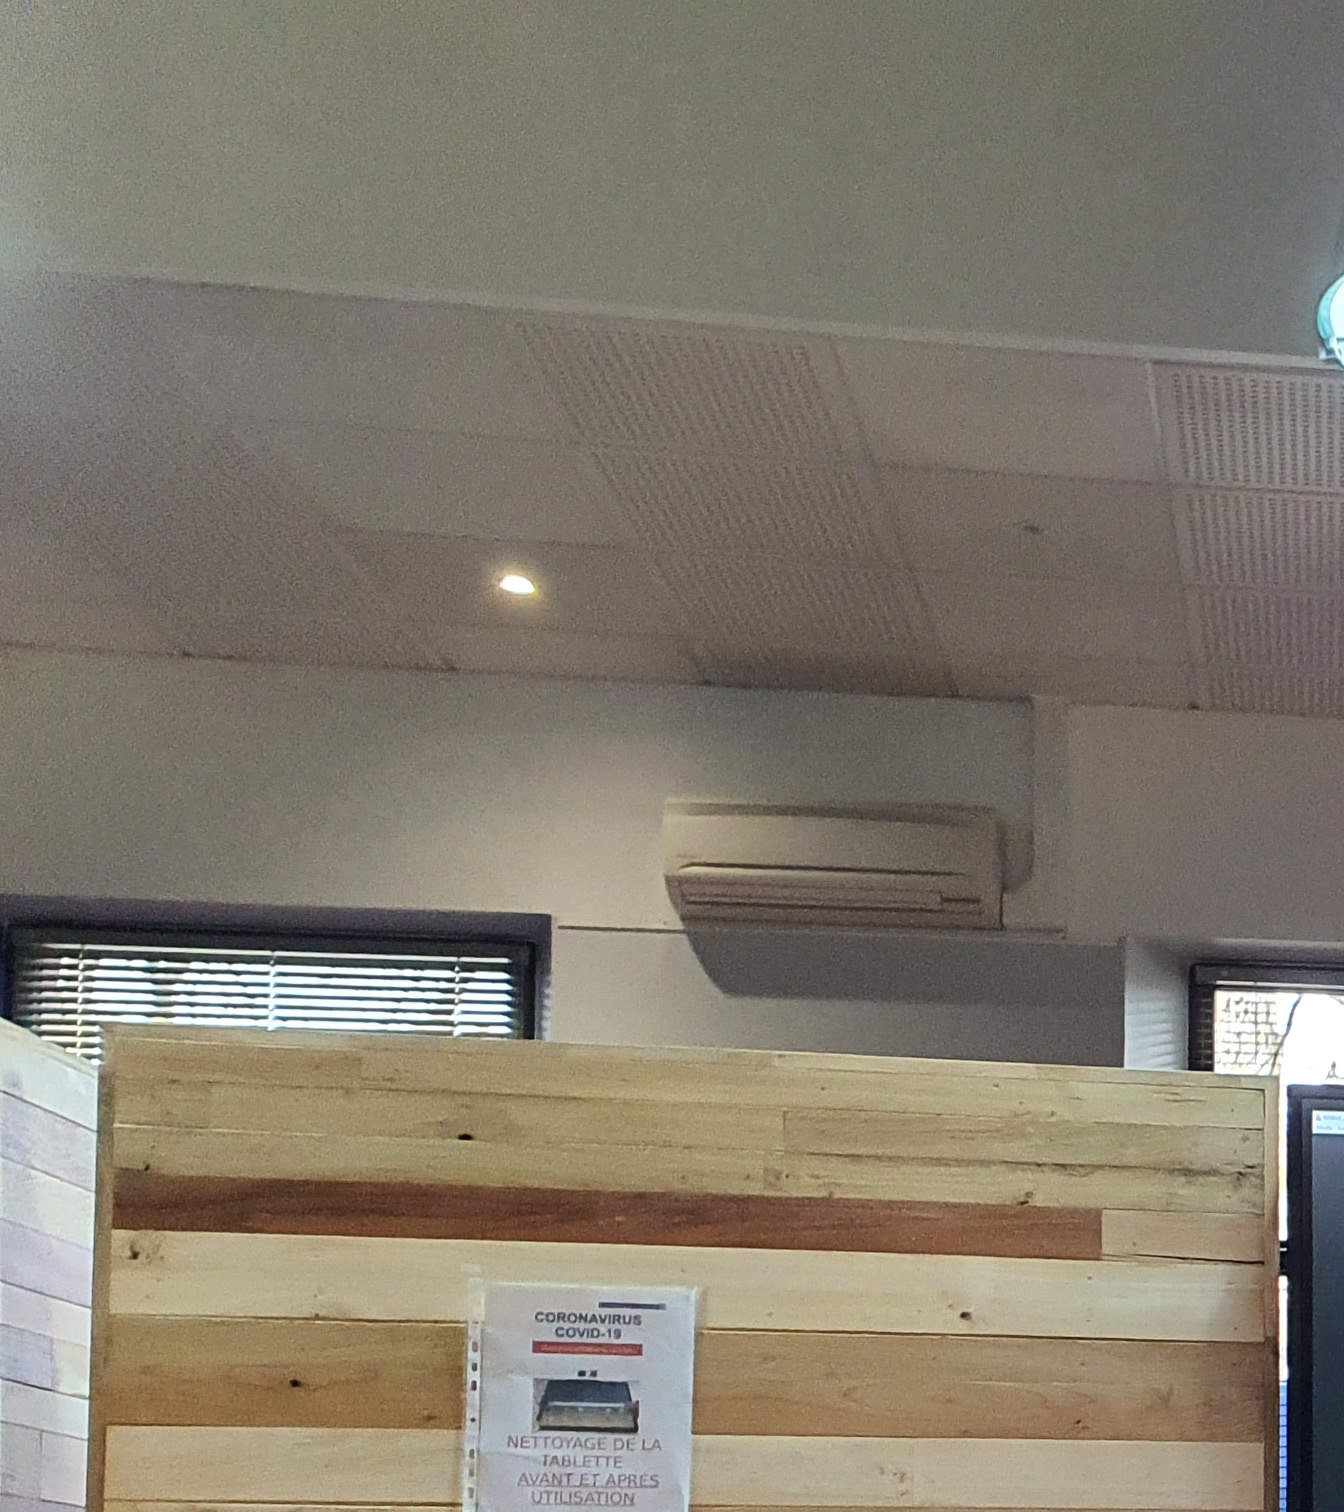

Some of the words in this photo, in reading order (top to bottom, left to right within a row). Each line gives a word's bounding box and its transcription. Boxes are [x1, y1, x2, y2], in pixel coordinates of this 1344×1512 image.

[534, 1311, 643, 1326] CORONAVIRUS
[555, 1326, 622, 1340] COVID-19
[507, 1435, 607, 1450] NETTOYAGE
[614, 1437, 635, 1450] DE
[642, 1438, 662, 1451] LA
[543, 1455, 623, 1468] TABLETTE
[517, 1472, 574, 1487] AVANT
[579, 1473, 600, 1487] ET
[531, 1490, 636, 1505] UTILISATION
